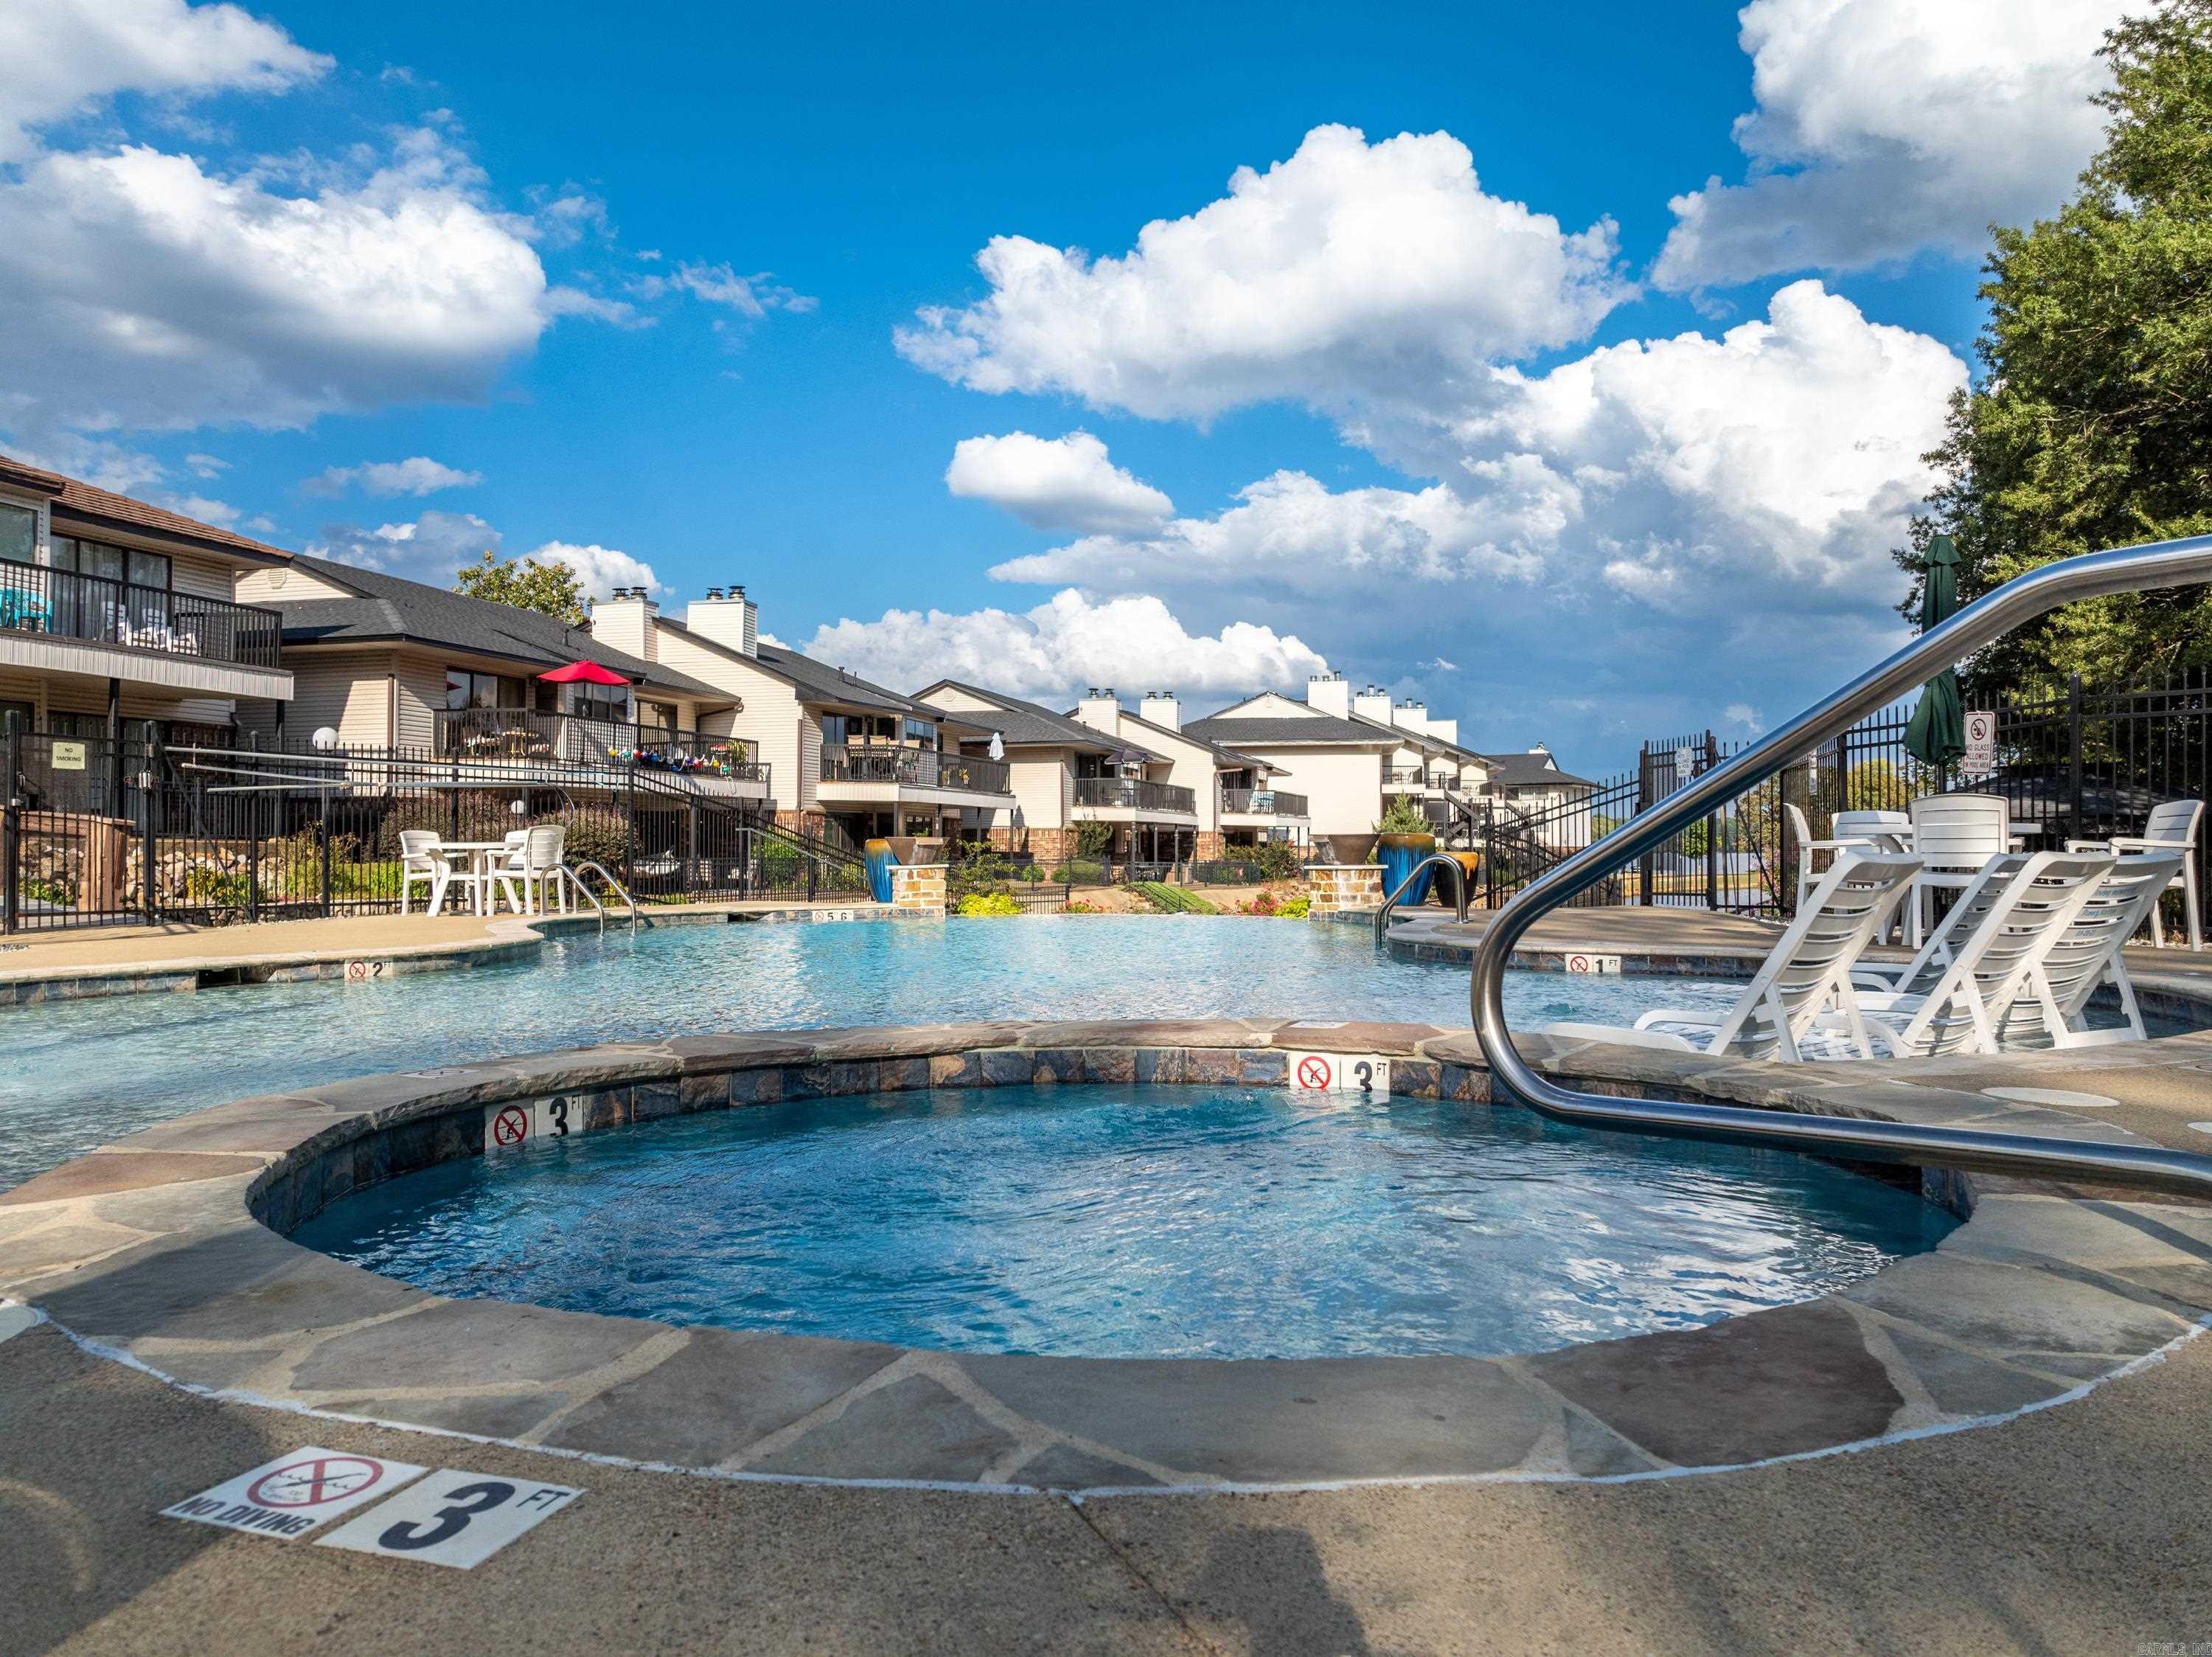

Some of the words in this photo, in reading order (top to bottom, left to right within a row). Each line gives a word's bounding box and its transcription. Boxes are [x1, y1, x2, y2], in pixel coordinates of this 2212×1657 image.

[372, 962, 383, 977] 2
[1596, 959, 1603, 973] 1
[1354, 1061, 1373, 1093] 3
[1377, 1062, 1387, 1076] FT
[549, 1097, 568, 1139] 3
[571, 1094, 582, 1111] FT
[173, 1496, 226, 1516] NO
[214, 1505, 316, 1535] DIVING
[378, 1481, 516, 1550] 3
[516, 1489, 571, 1511] FT
